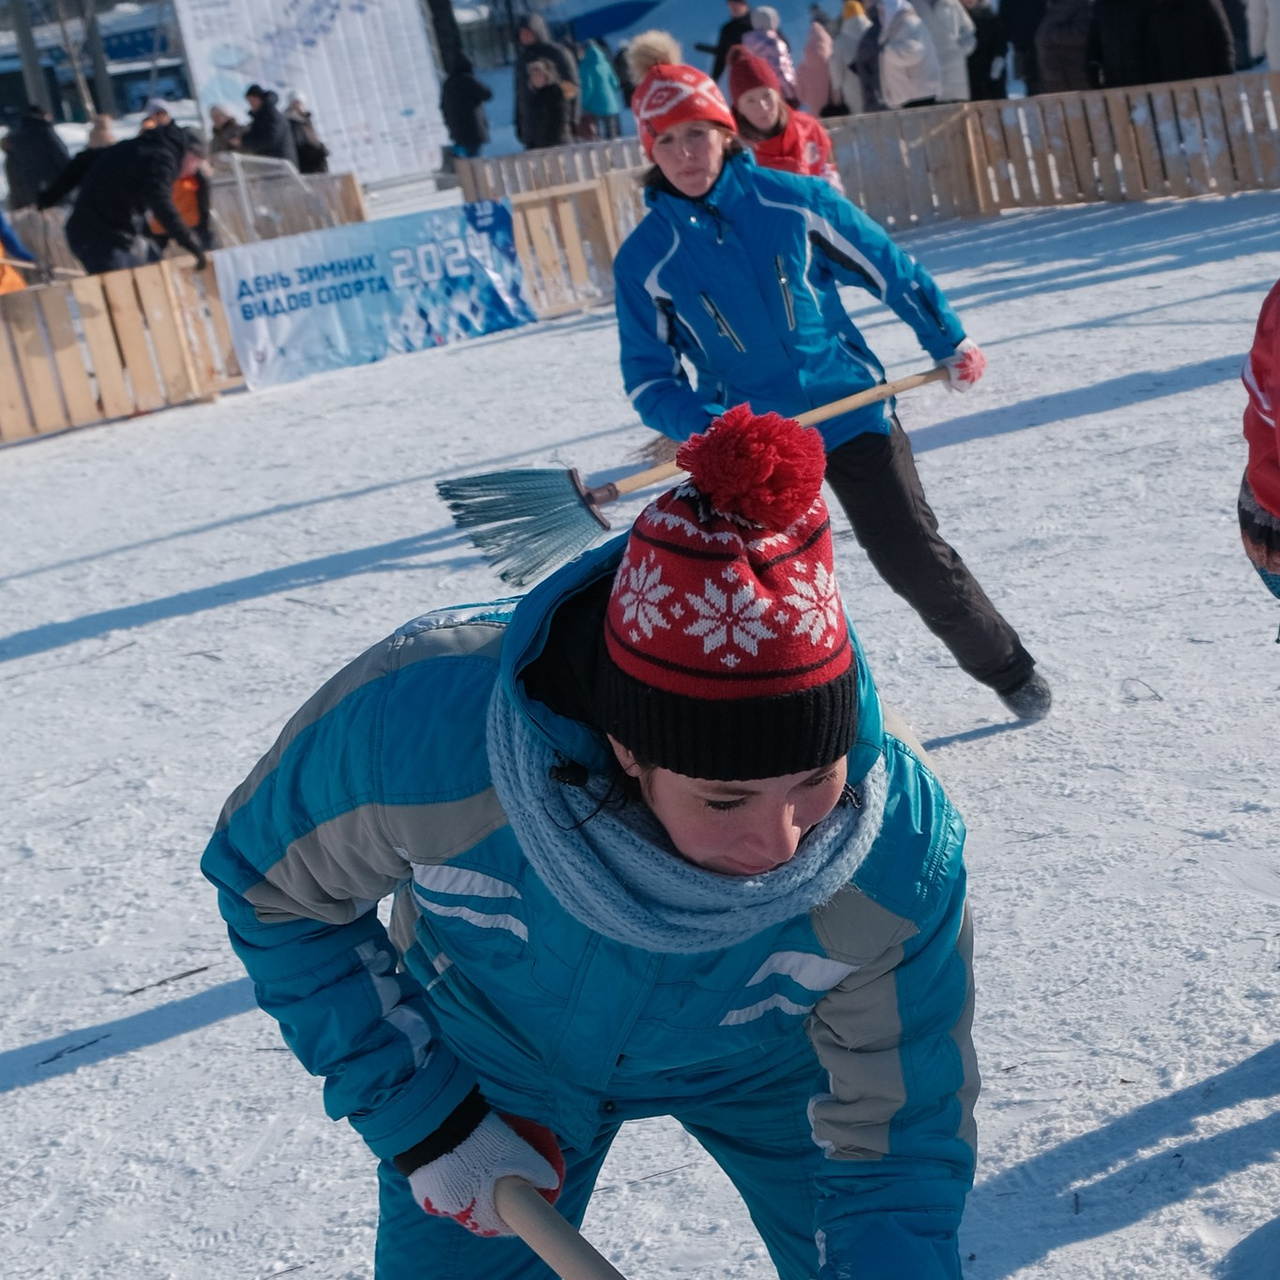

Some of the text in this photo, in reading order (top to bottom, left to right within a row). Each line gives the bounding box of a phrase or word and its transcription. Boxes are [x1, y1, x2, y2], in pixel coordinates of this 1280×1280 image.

[237, 254, 376, 300] ДЕНЬ ЗИМНИХ
[390, 228, 494, 288] 2024
[241, 276, 390, 321] ВИДОВ СПОРТА
